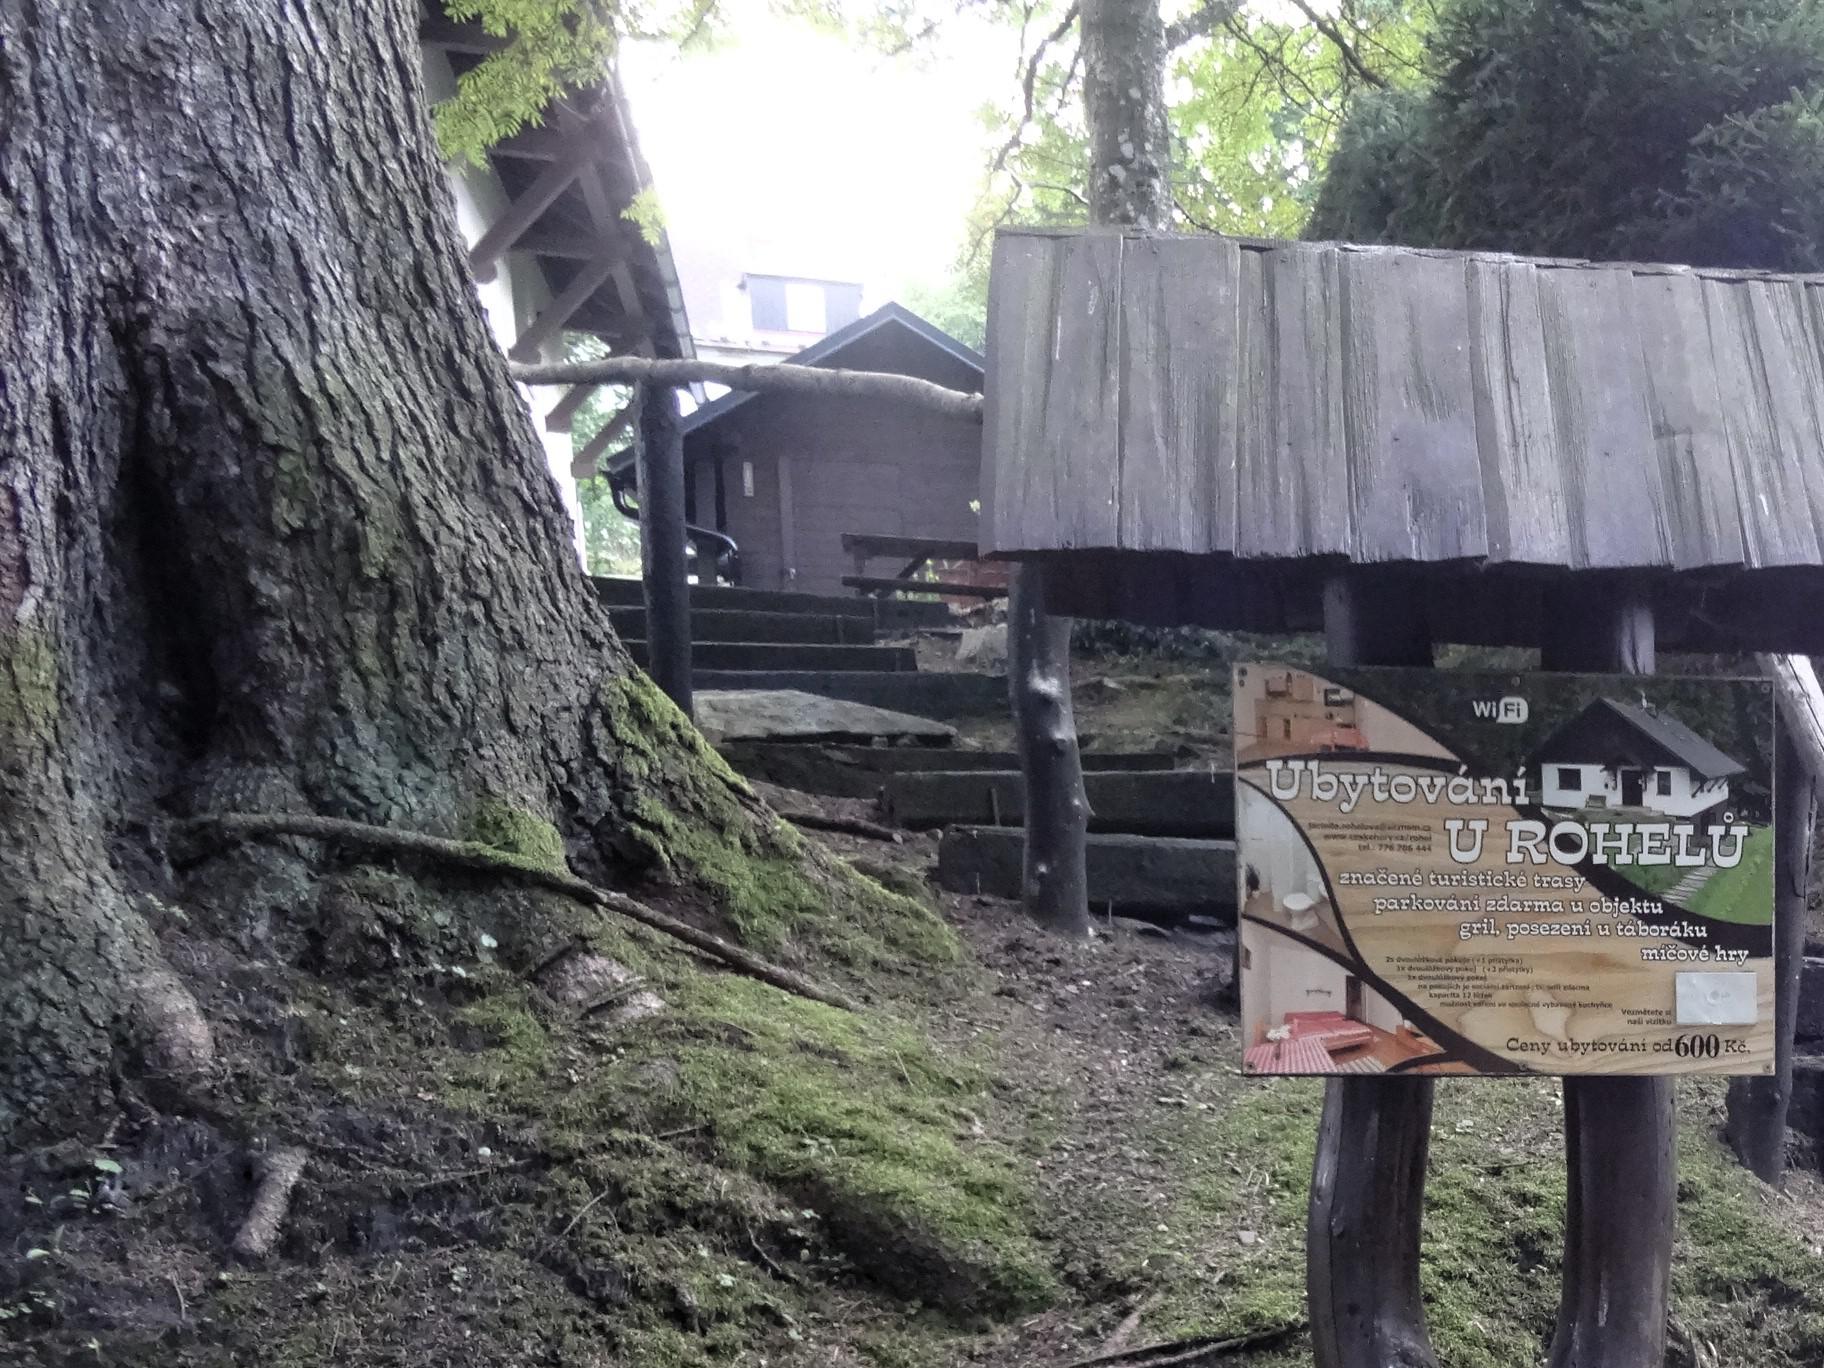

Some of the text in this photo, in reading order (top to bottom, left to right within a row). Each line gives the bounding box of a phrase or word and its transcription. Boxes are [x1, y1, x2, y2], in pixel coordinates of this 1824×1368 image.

[1472, 698, 1526, 721] WiFi
[1265, 760, 1530, 814] Ubytování
[1444, 812, 1750, 868] U ROHELŮ
[1339, 868, 1587, 893] značené turistické trasy
[1373, 893, 1664, 918] parkování zdarma u objektu
[1459, 917, 1708, 940] gril, posezení u táboráku
[1641, 943, 1750, 966] míčové hry
[1506, 1033, 1750, 1058] Ceny ubytování od 600 Kč.
